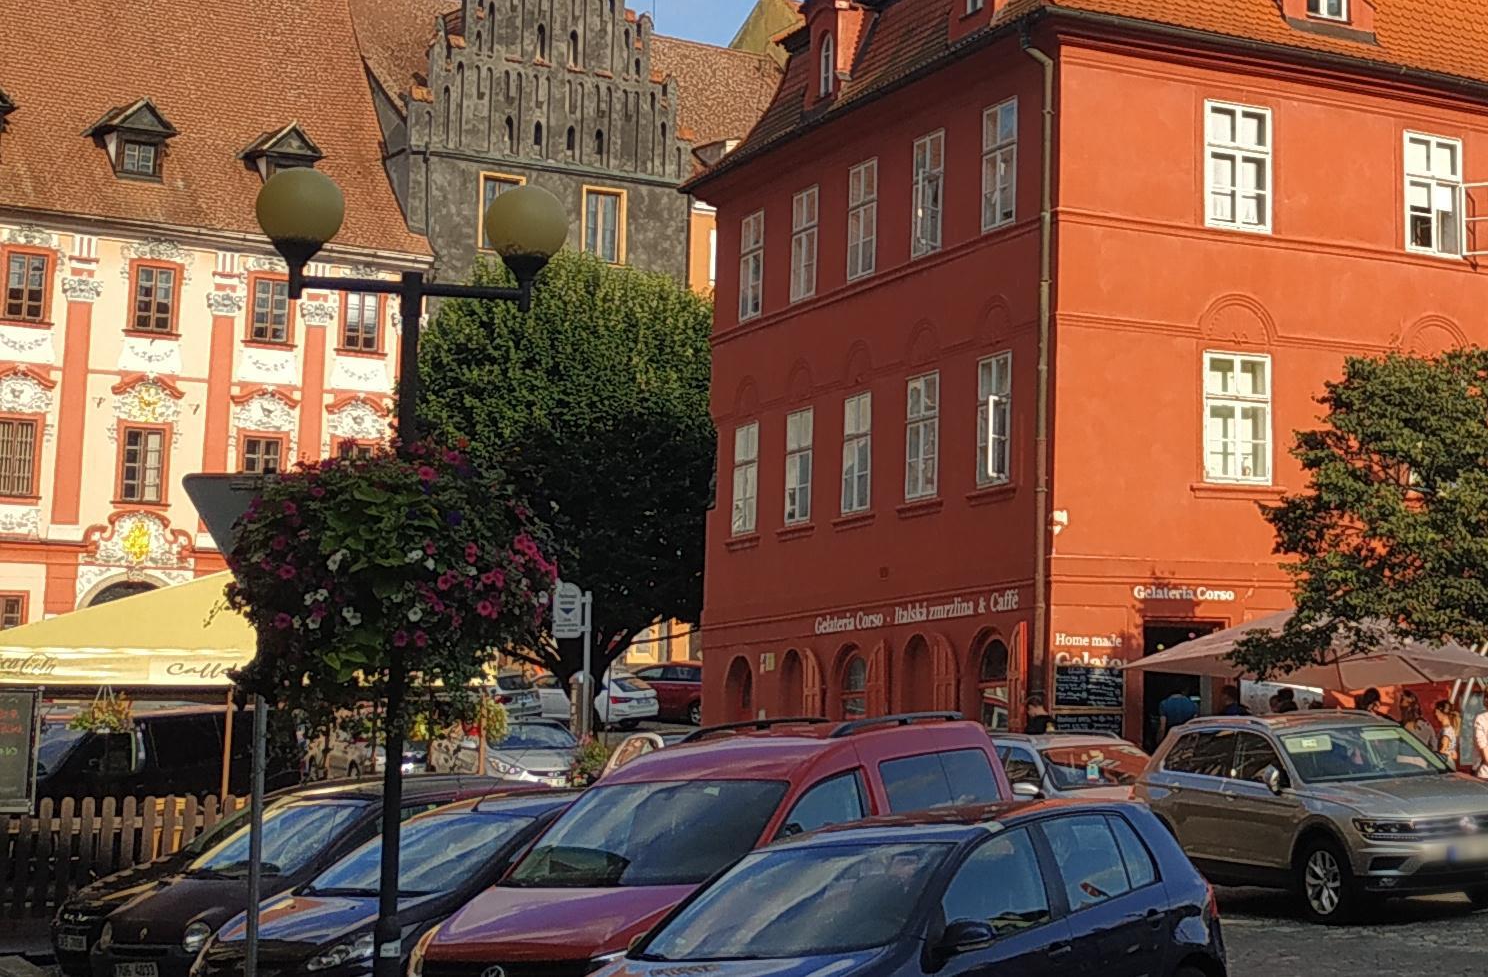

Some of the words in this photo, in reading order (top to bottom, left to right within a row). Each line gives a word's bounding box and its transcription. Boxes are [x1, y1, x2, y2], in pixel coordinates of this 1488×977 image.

[1133, 585, 1193, 600] Gelateria
[1196, 586, 1235, 601] Corso
[815, 612, 855, 635] Gelateria
[855, 611, 884, 630] Corso
[928, 597, 974, 620] zmrzlina
[978, 597, 986, 614] &
[1056, 632, 1089, 646] Home
[1091, 633, 1122, 647] made
